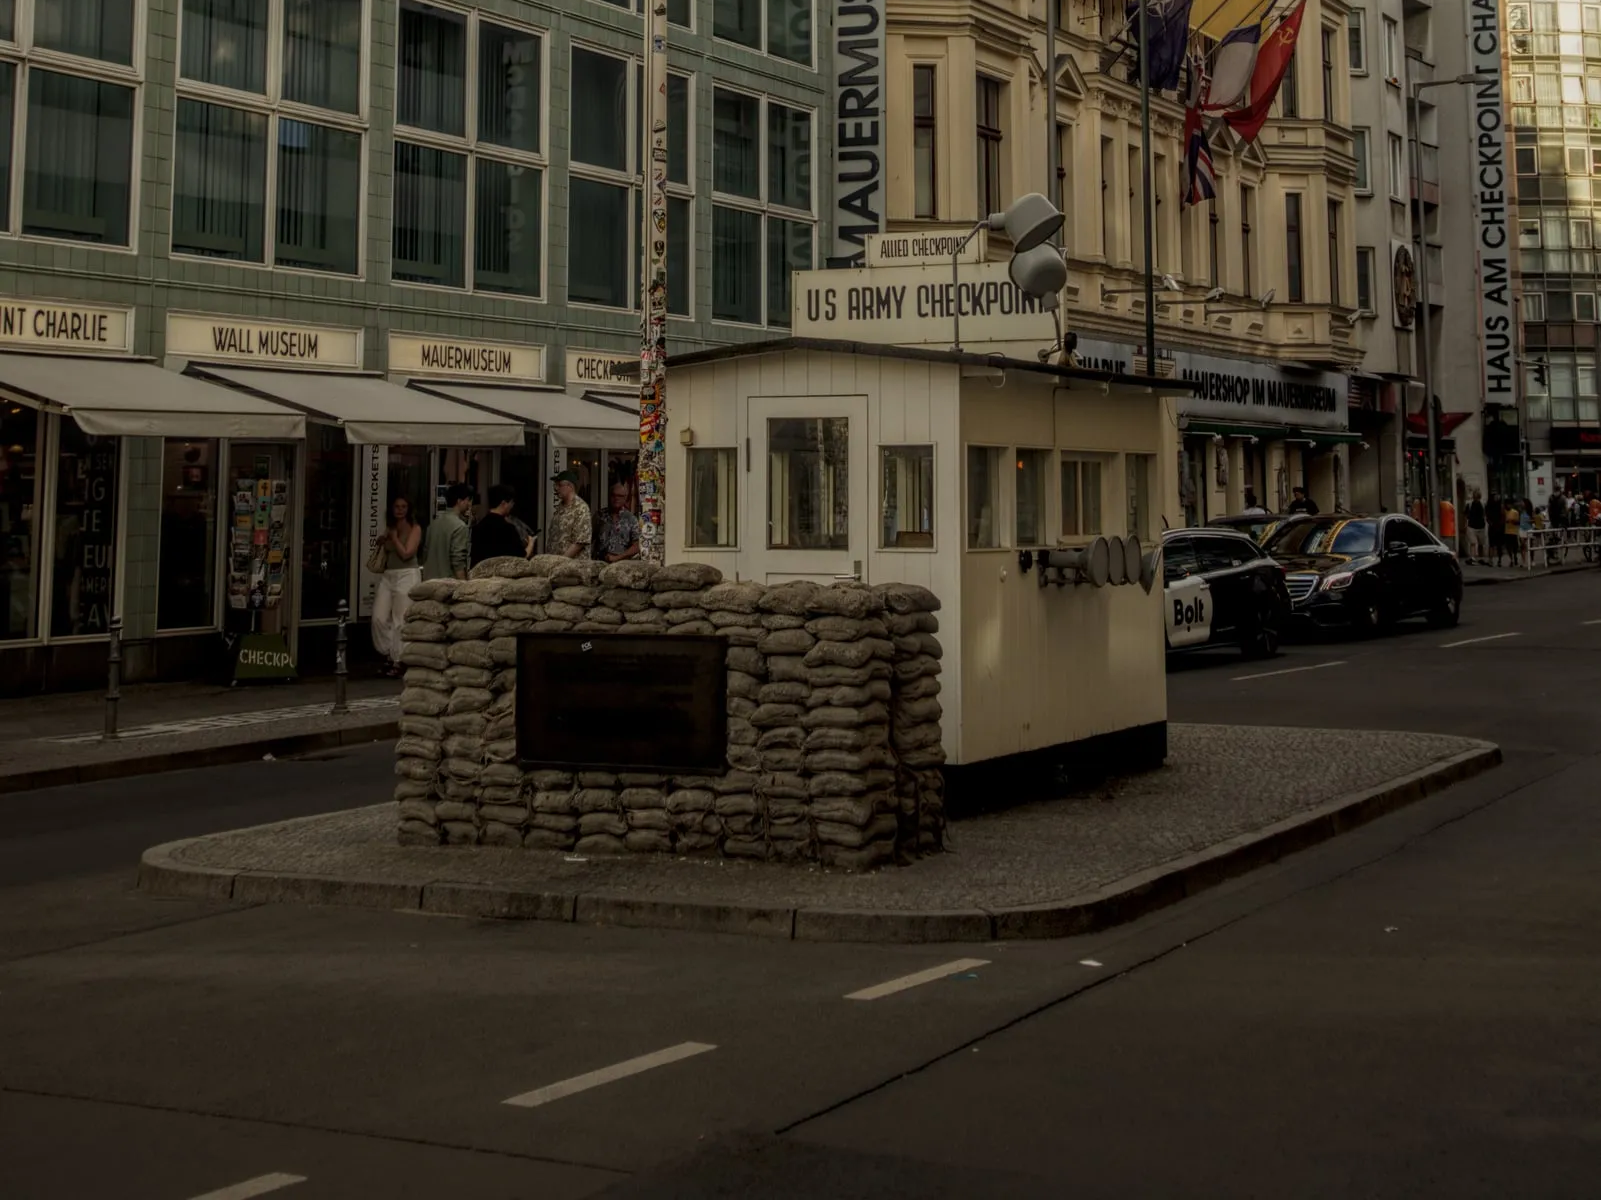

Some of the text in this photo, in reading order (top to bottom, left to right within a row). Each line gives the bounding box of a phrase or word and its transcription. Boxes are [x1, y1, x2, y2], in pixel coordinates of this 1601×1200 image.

[1475, 65, 1506, 249] CHECKPOINT
[880, 236, 968, 259] ALLIED CHECKPOINT
[1483, 258, 1508, 306] AM
[848, 285, 906, 321] ARMY
[0, 306, 107, 342] NT CHARLIE
[212, 326, 318, 358] WALL MUSEUM
[421, 344, 511, 373] MAUERMUSEUM
[1485, 315, 1511, 393] HAUS
[1252, 378, 1265, 406] IM
[1267, 379, 1336, 412] MAUERMUSEUM
[1174, 597, 1204, 627] Bolt
